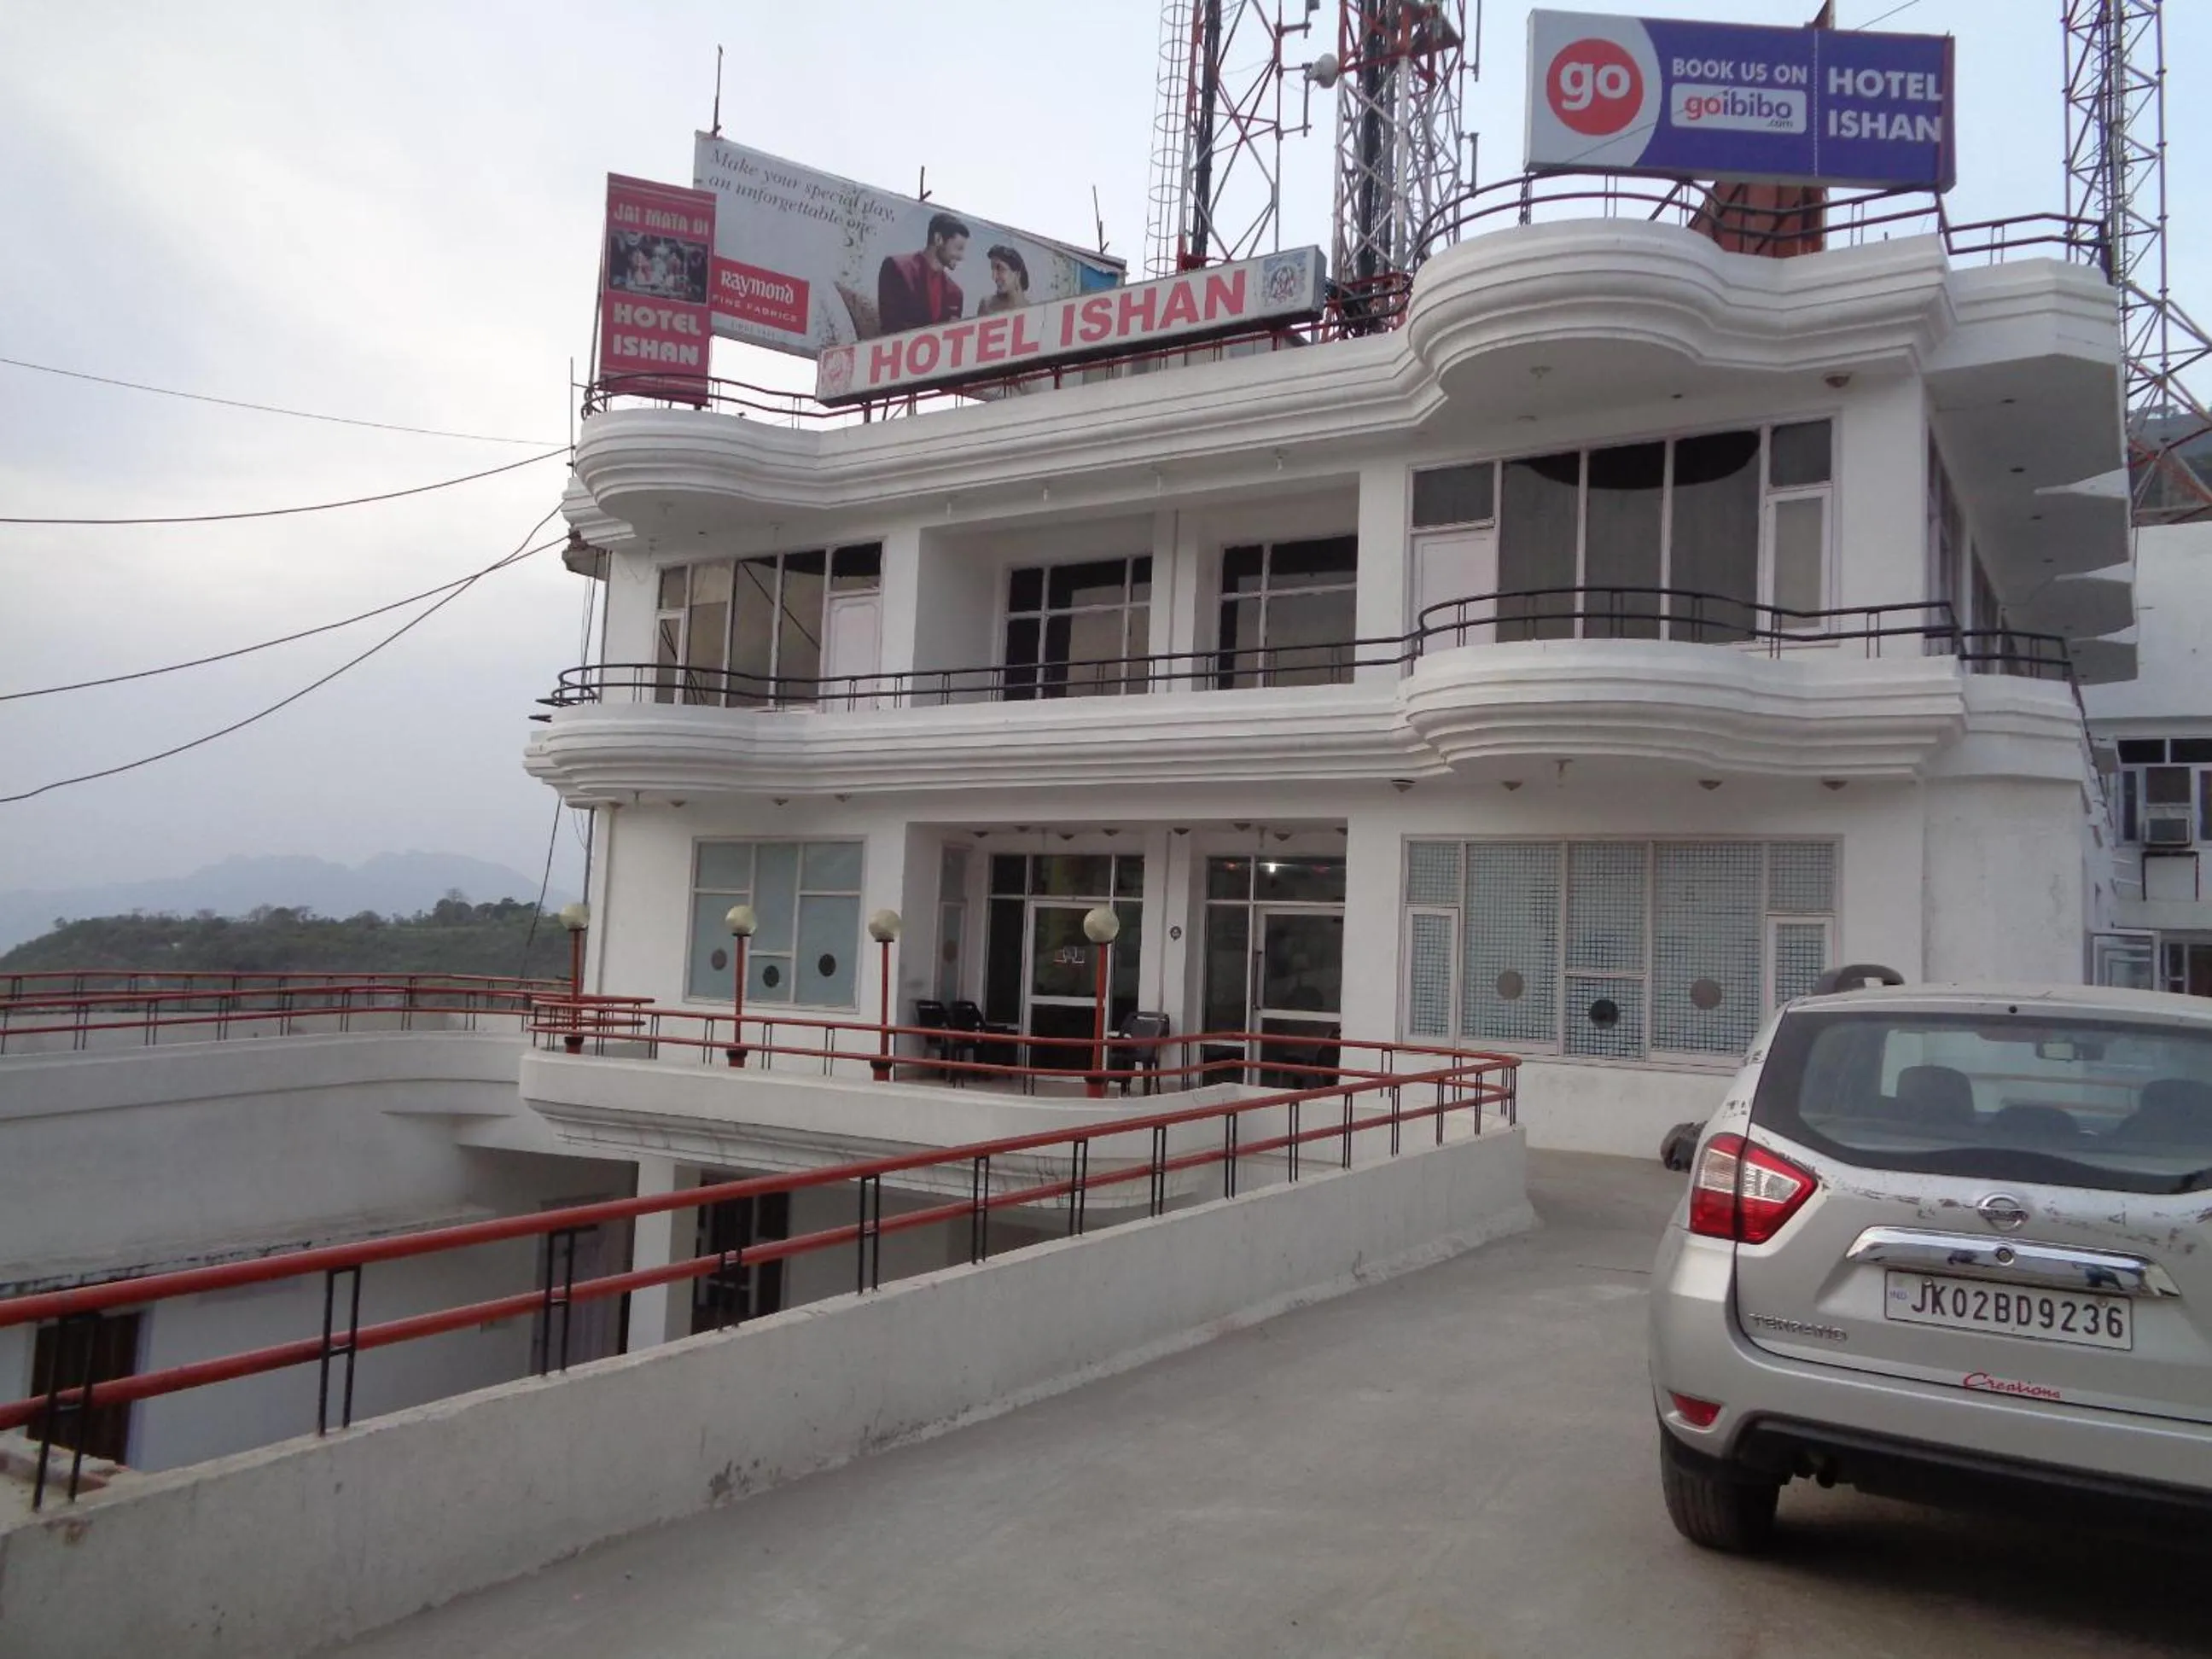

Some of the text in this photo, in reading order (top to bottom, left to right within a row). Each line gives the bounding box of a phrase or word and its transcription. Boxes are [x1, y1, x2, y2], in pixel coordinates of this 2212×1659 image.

[1559, 61, 1631, 111] go
[1672, 58, 1807, 84] BOOK US ON
[1828, 67, 1943, 102] HOTEL
[1685, 91, 1792, 122] goibibo
[1828, 109, 1942, 143] ISHAN
[710, 148, 759, 177] Make
[763, 168, 798, 190] your
[708, 175, 731, 191] an
[736, 181, 843, 225] unforgettable
[614, 202, 640, 221] JAI
[692, 218, 709, 236] DI
[720, 270, 794, 306] Raymond
[613, 301, 701, 336] HOTEL
[746, 302, 798, 323] FABRICS
[869, 269, 1246, 384] HOTEL ISHAN
[613, 334, 699, 367] ISHAN
[1911, 1280, 2124, 1339] JK02BD9236
[1963, 1371, 2062, 1400] Creations
